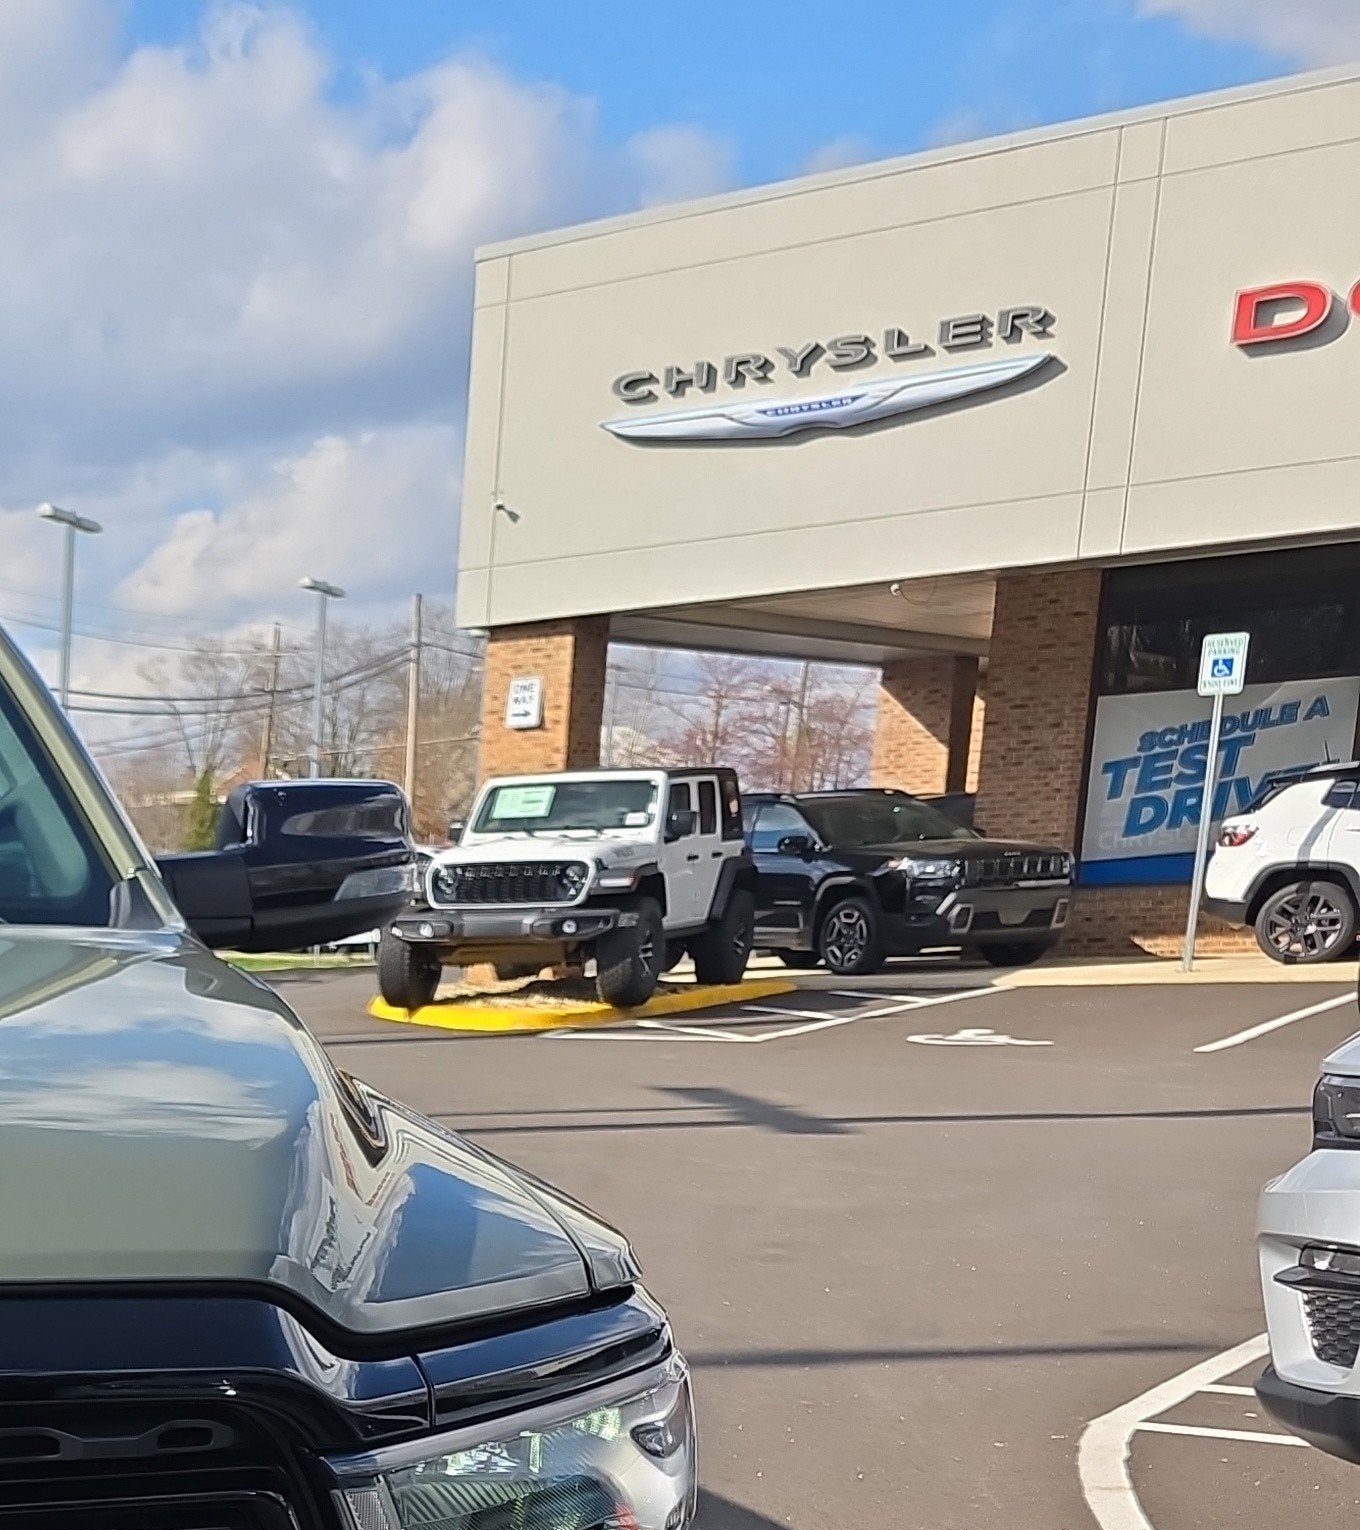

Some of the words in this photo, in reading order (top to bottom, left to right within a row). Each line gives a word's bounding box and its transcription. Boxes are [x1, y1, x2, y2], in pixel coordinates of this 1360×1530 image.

[1230, 275, 1360, 346] D
[612, 305, 1058, 402] CHRYSLER
[1303, 694, 1330, 721] A
[1101, 733, 1256, 800] TEST
[1121, 762, 1321, 838] DRIV
